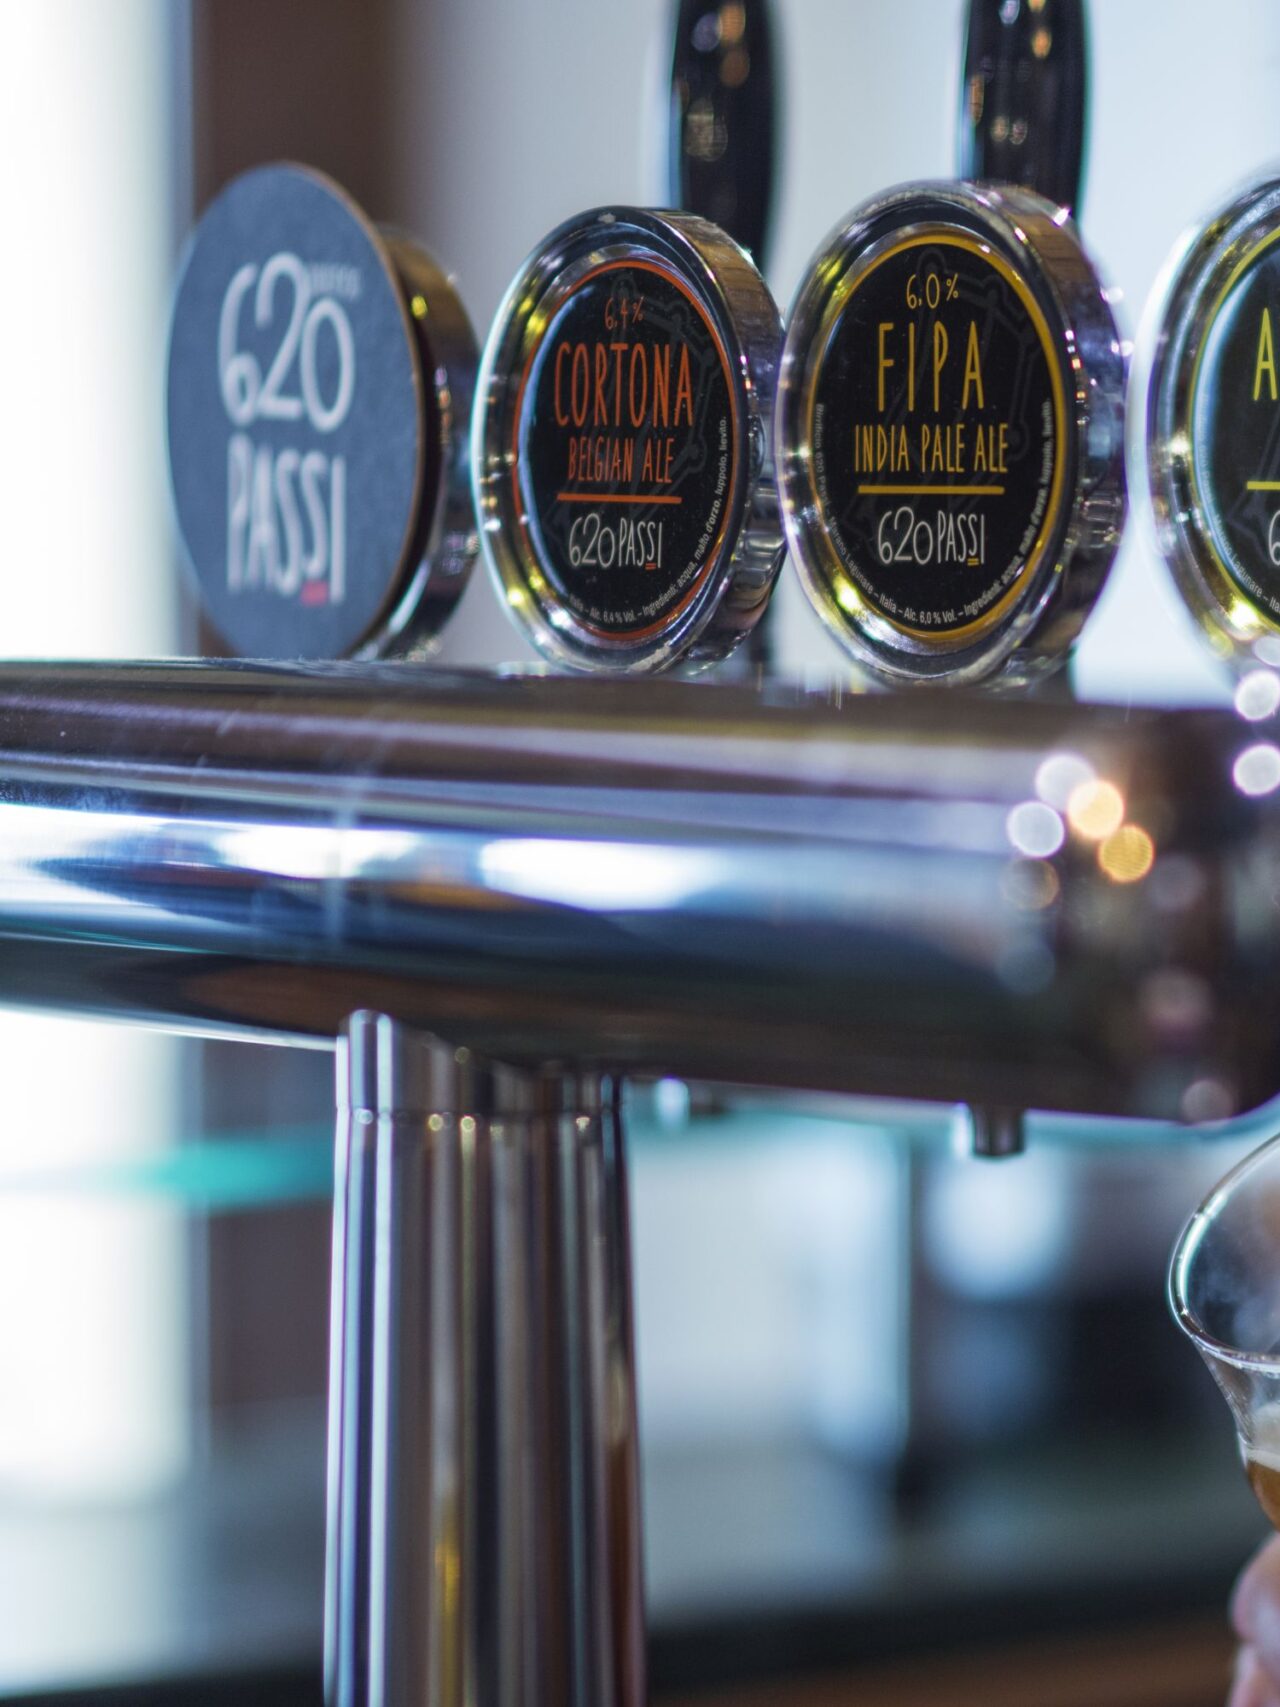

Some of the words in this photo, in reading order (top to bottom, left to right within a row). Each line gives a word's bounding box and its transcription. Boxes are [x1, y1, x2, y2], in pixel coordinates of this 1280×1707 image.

[217, 251, 355, 433] 620
[554, 341, 693, 428] CORTONA
[878, 320, 984, 412] FIPA
[568, 436, 633, 482] BELGIAN
[642, 437, 675, 484] ALE
[855, 424, 909, 473] INDIA
[921, 424, 965, 473] PALE
[974, 423, 1009, 473] ALE
[227, 432, 347, 604] PASSI
